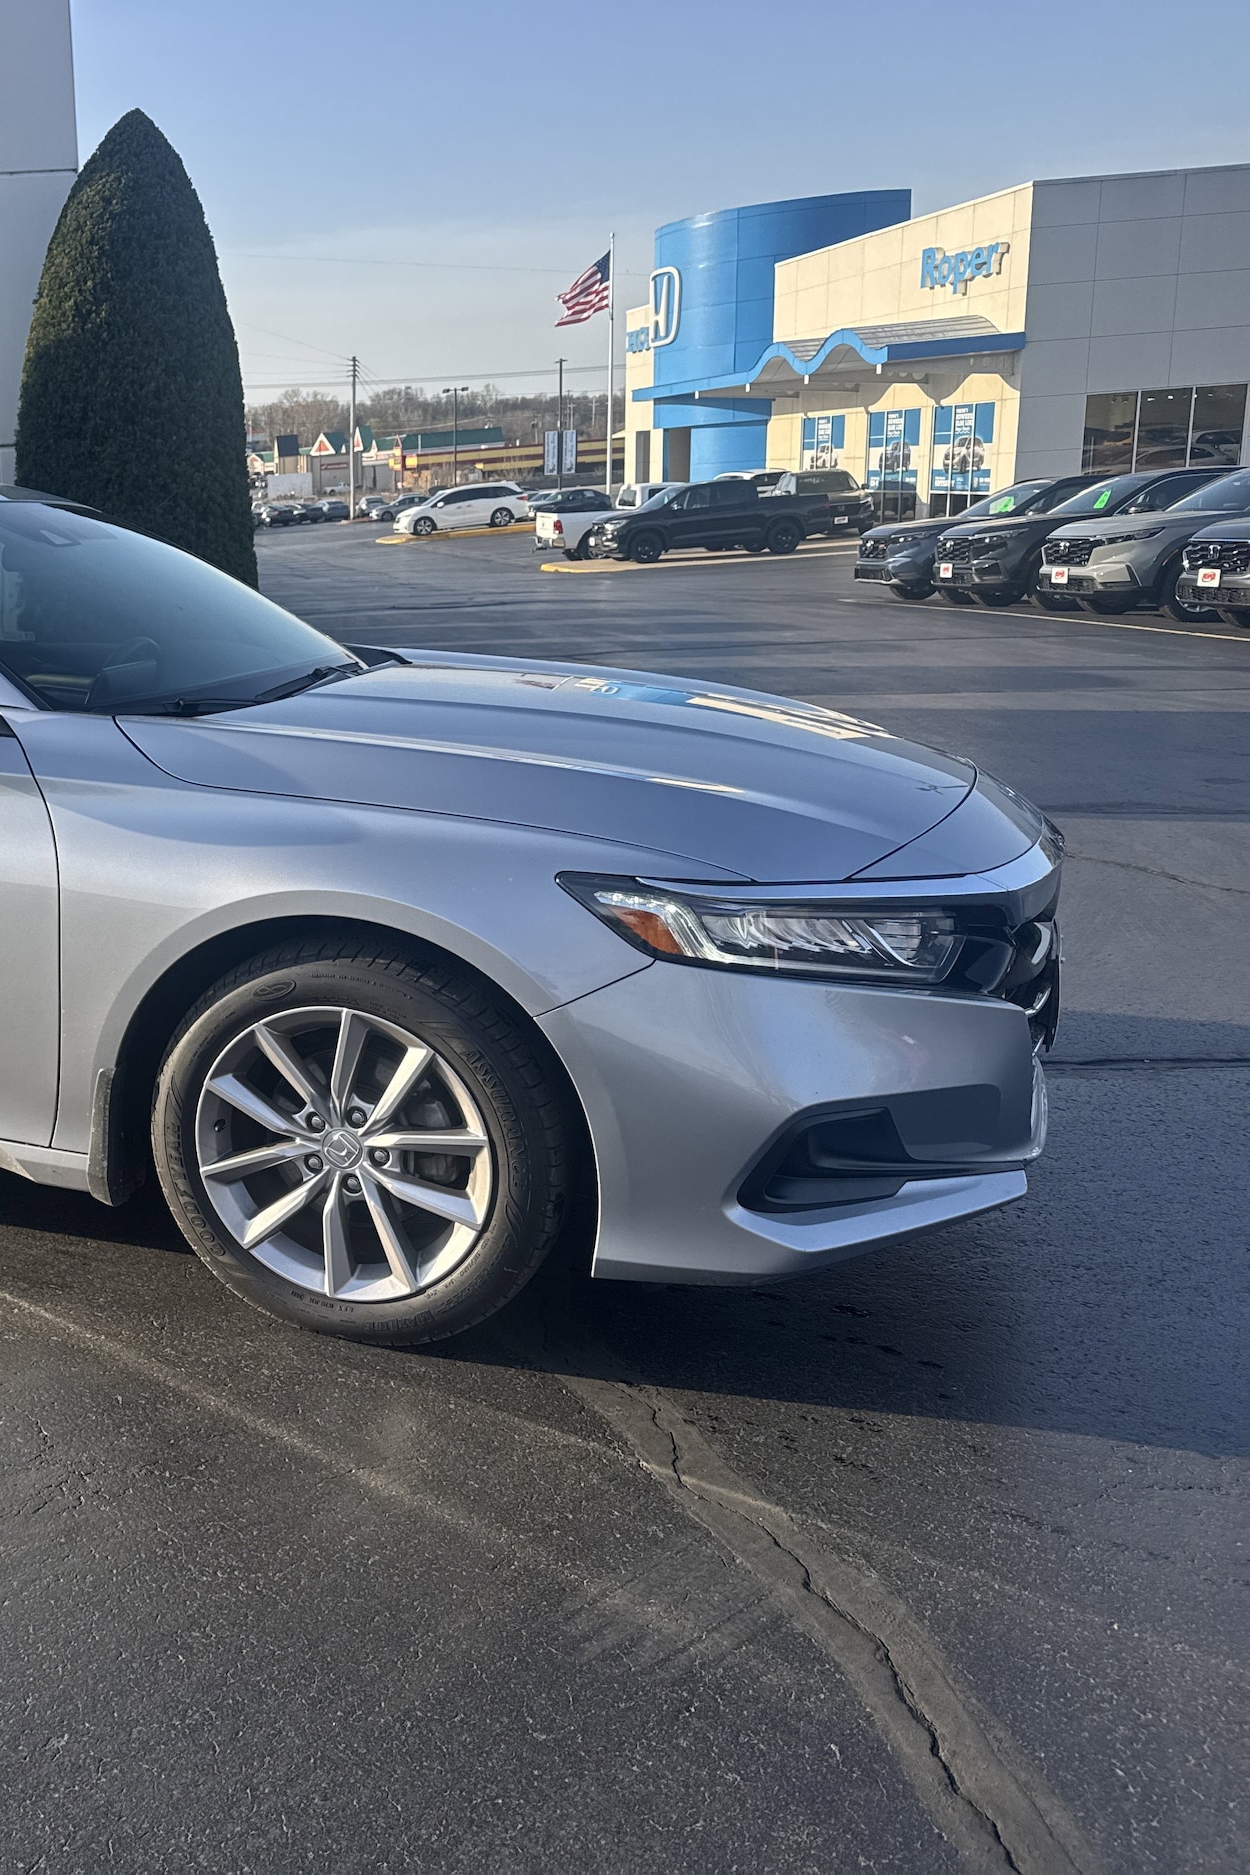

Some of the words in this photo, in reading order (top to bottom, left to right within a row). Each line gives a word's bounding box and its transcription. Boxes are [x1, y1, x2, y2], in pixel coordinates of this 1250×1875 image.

[920, 242, 1003, 295] Roper
[461, 1048, 528, 1190] ASSURANCE
[165, 1121, 226, 1257] GOODYEAR
